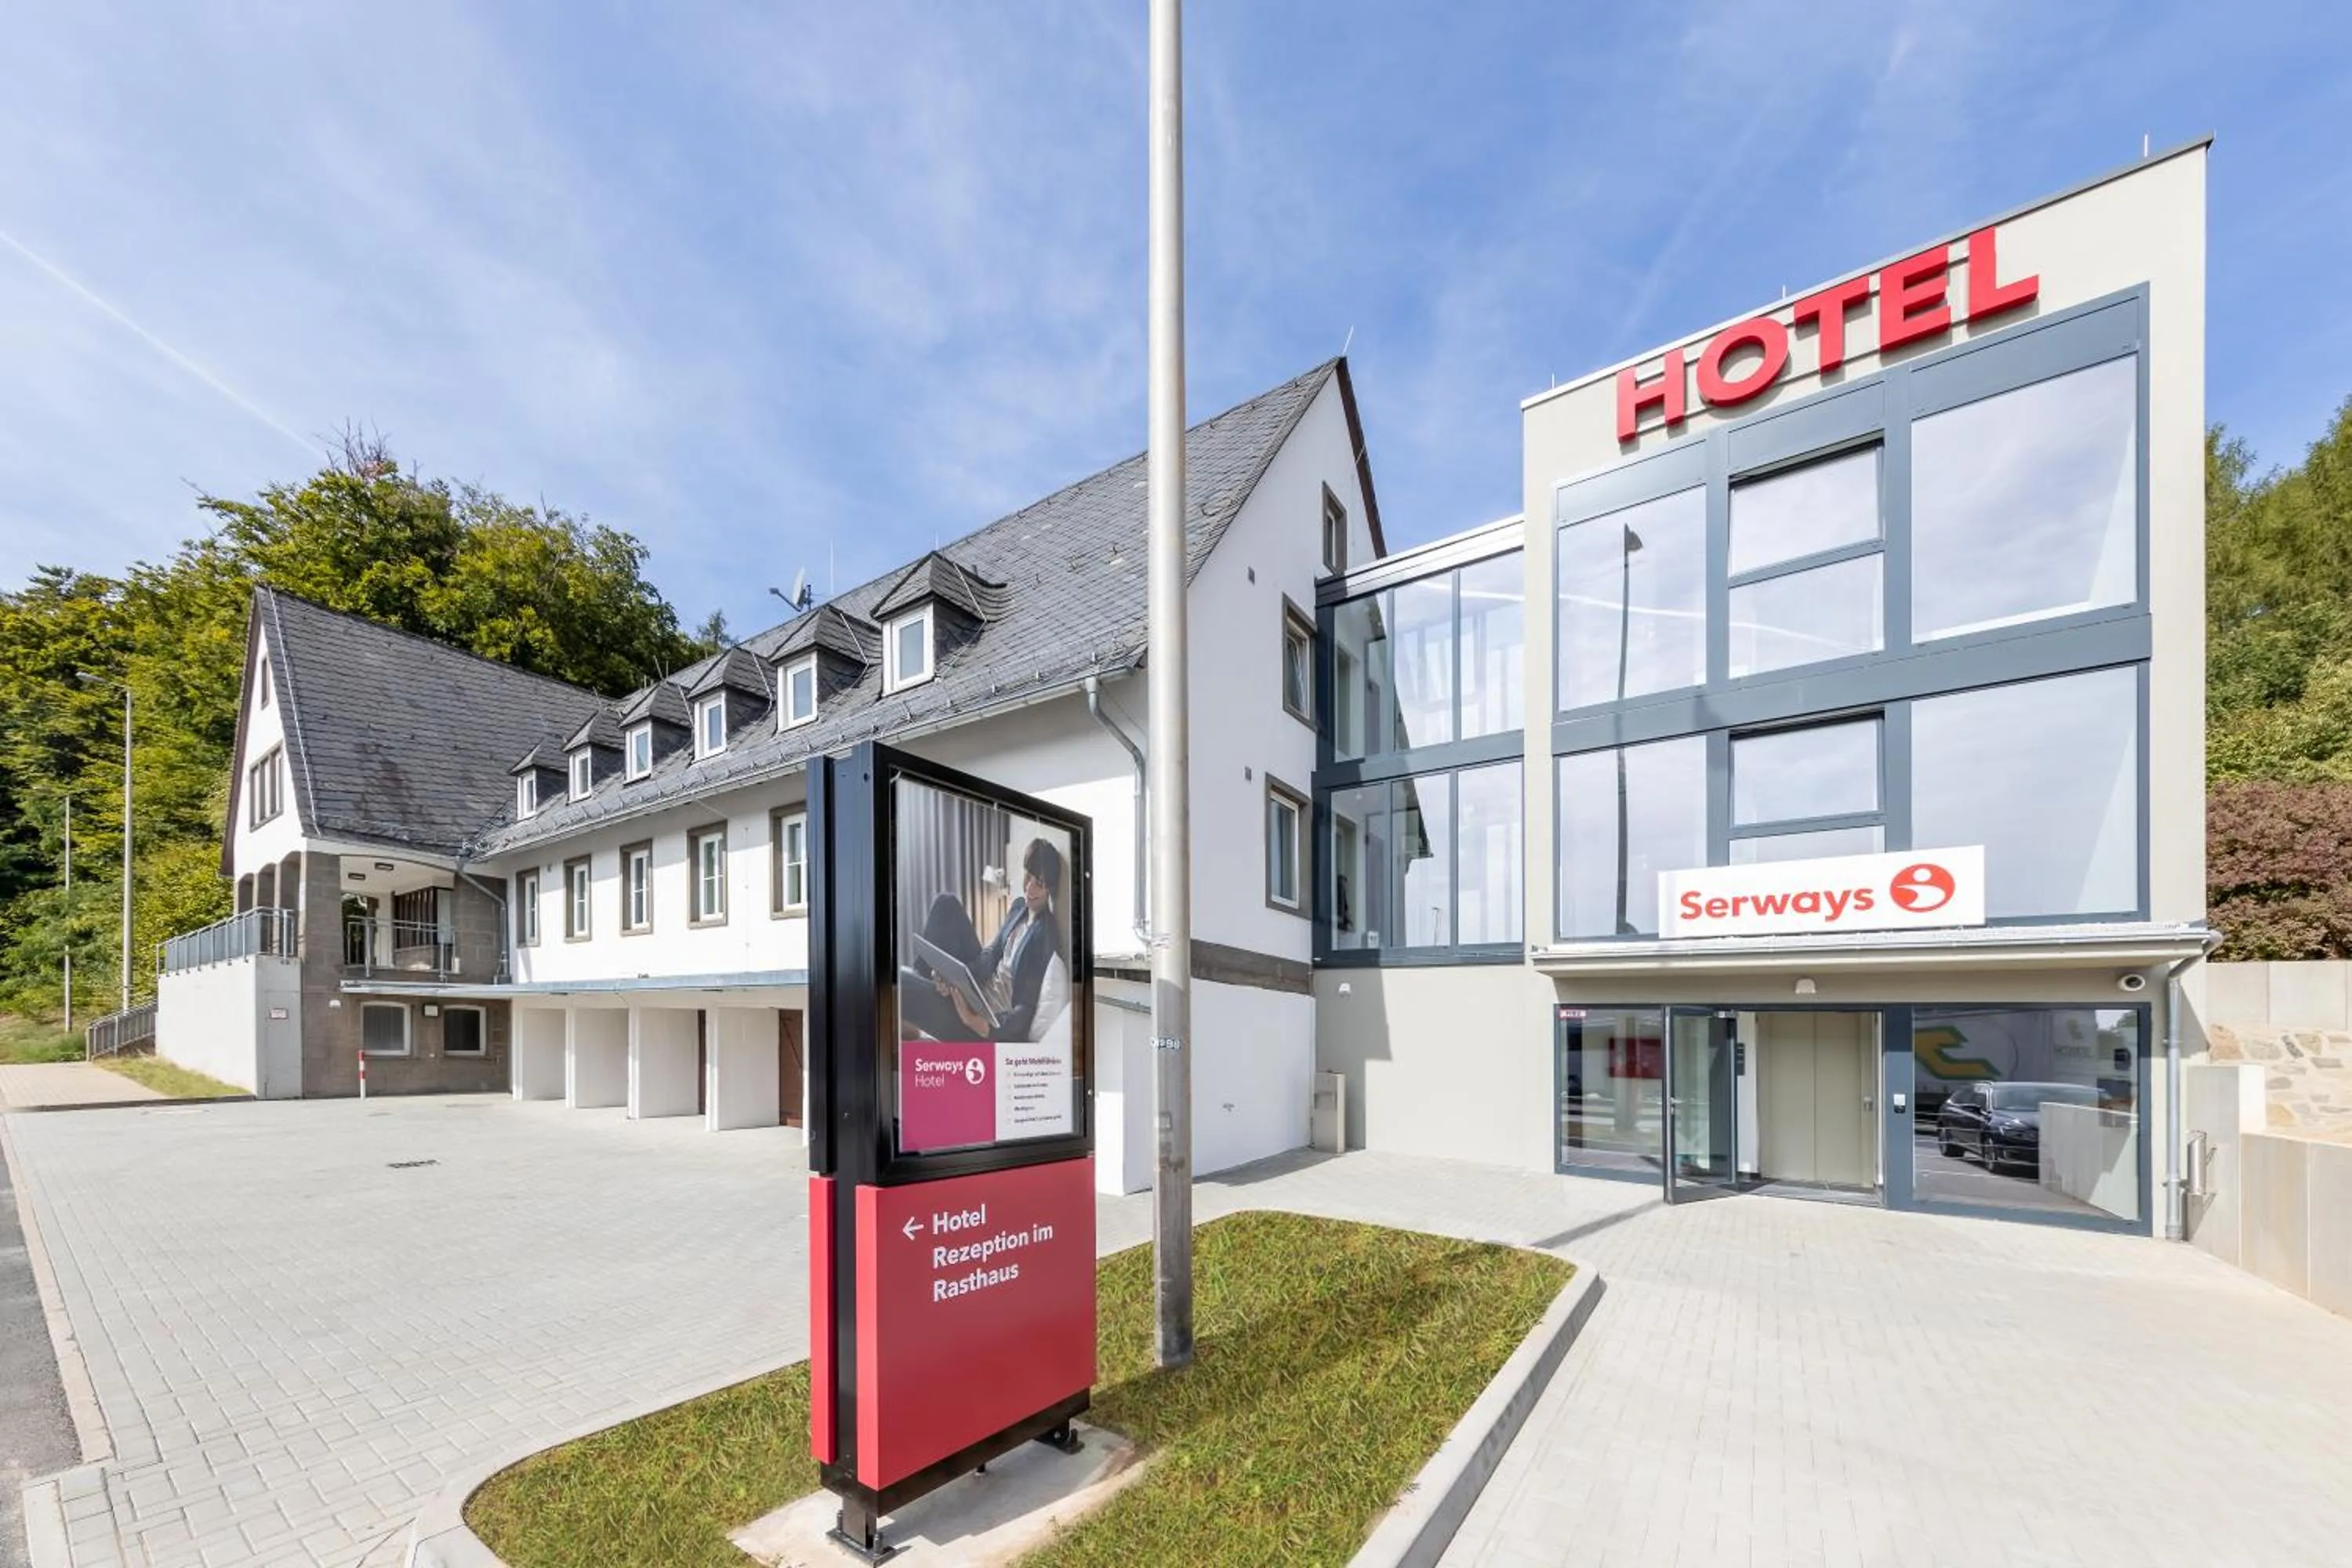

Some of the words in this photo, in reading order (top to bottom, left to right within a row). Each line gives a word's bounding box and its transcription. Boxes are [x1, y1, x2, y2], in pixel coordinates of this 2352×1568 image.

[1616, 226, 2039, 444] HOTEL
[1679, 887, 1875, 922] Serways
[914, 1058, 964, 1075] Serways
[915, 1073, 945, 1087] Hotel
[932, 1203, 986, 1235] Hotel
[933, 1230, 1029, 1269] Rezeption
[1033, 1223, 1053, 1243] im
[933, 1264, 1019, 1302] Rasthaus
